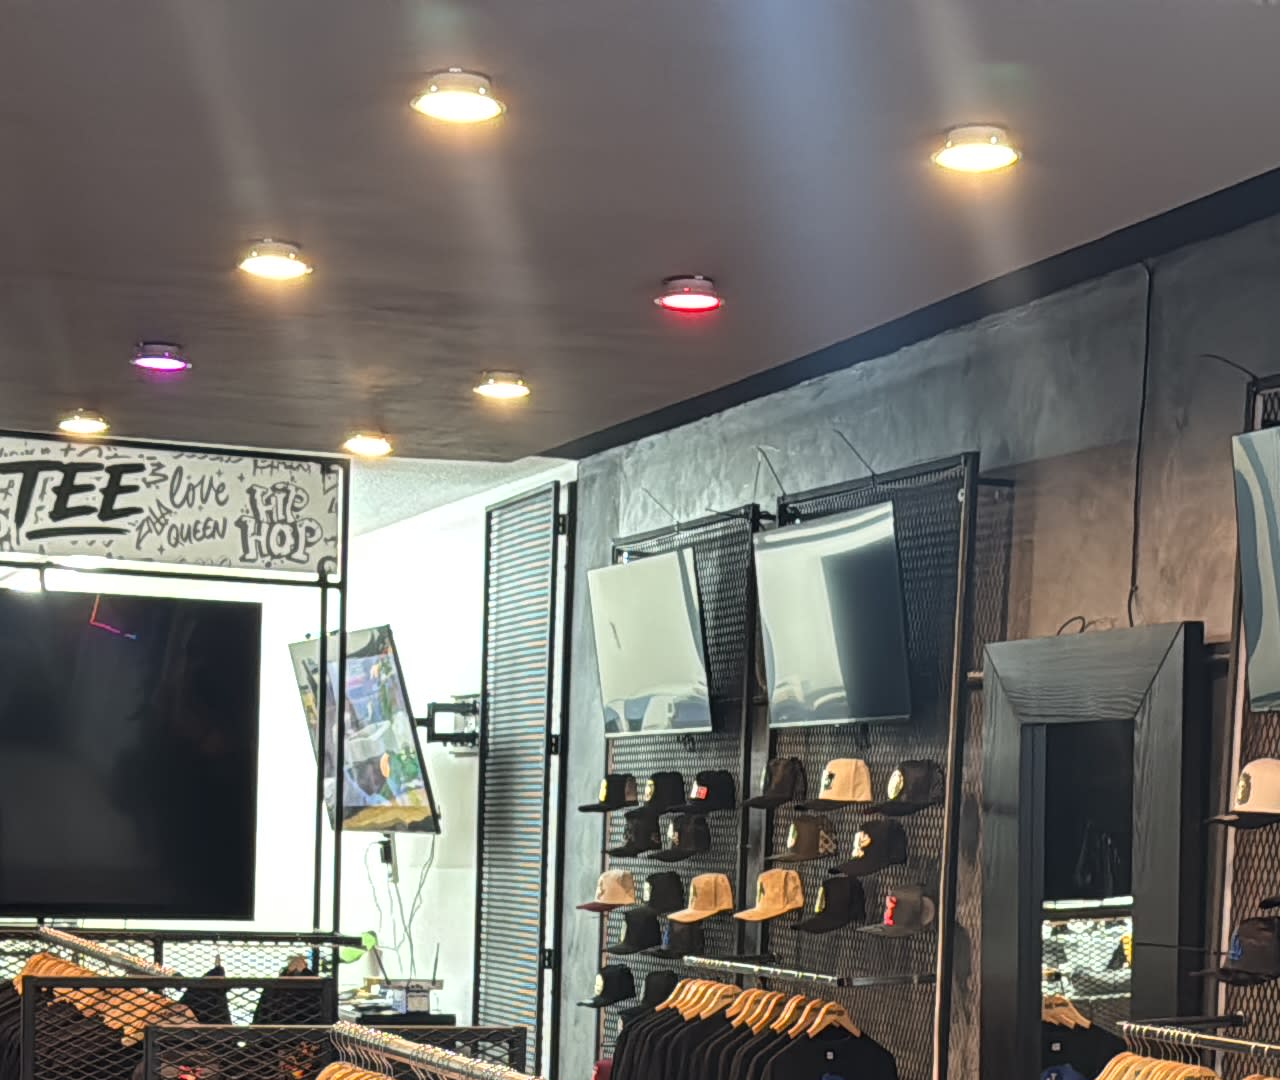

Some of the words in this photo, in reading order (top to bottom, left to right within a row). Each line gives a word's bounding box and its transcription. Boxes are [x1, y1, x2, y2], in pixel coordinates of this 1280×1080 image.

[246, 481, 310, 522] HIP
[167, 516, 228, 548] QUEEN
[235, 515, 324, 564] HOP
